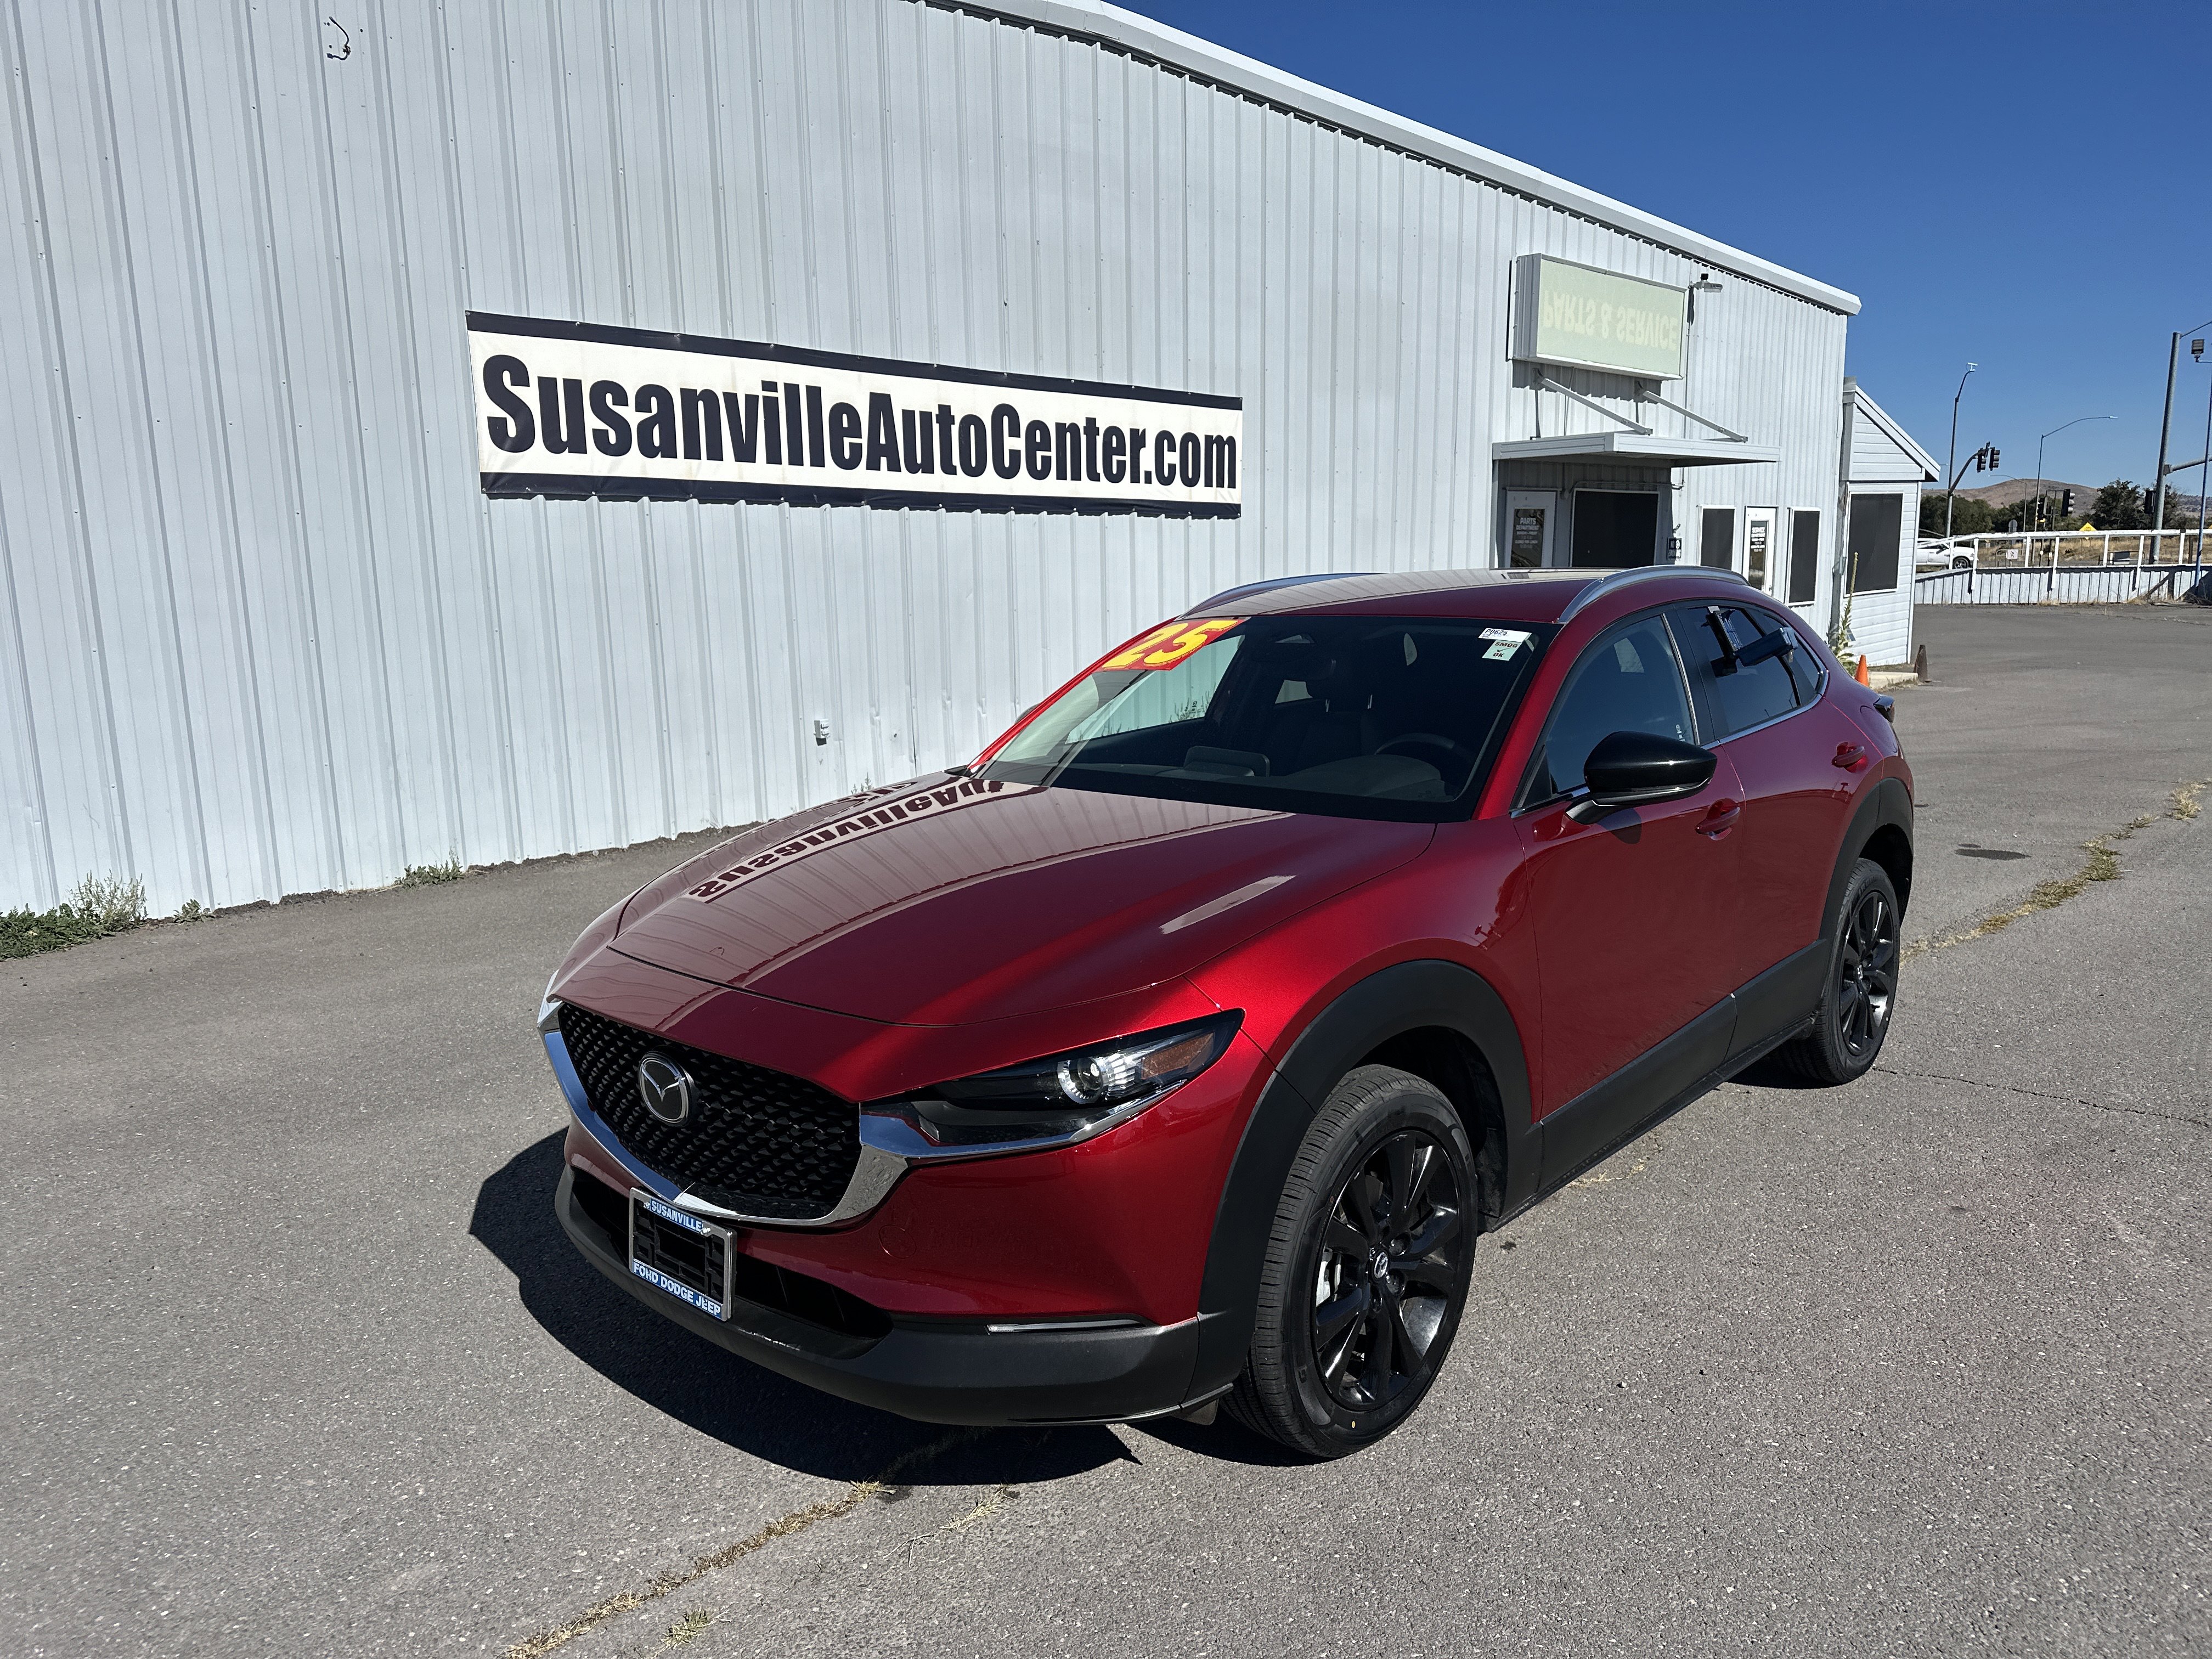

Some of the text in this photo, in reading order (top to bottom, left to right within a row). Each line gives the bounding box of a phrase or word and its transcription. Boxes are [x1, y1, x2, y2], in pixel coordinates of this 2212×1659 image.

[483, 354, 1237, 489] SusanvilleAutoCenter.com
[1102, 620, 1238, 669] 25
[651, 1200, 703, 1232] SUSANVILLE
[634, 1262, 721, 1316] FORD DODGE JEEP
